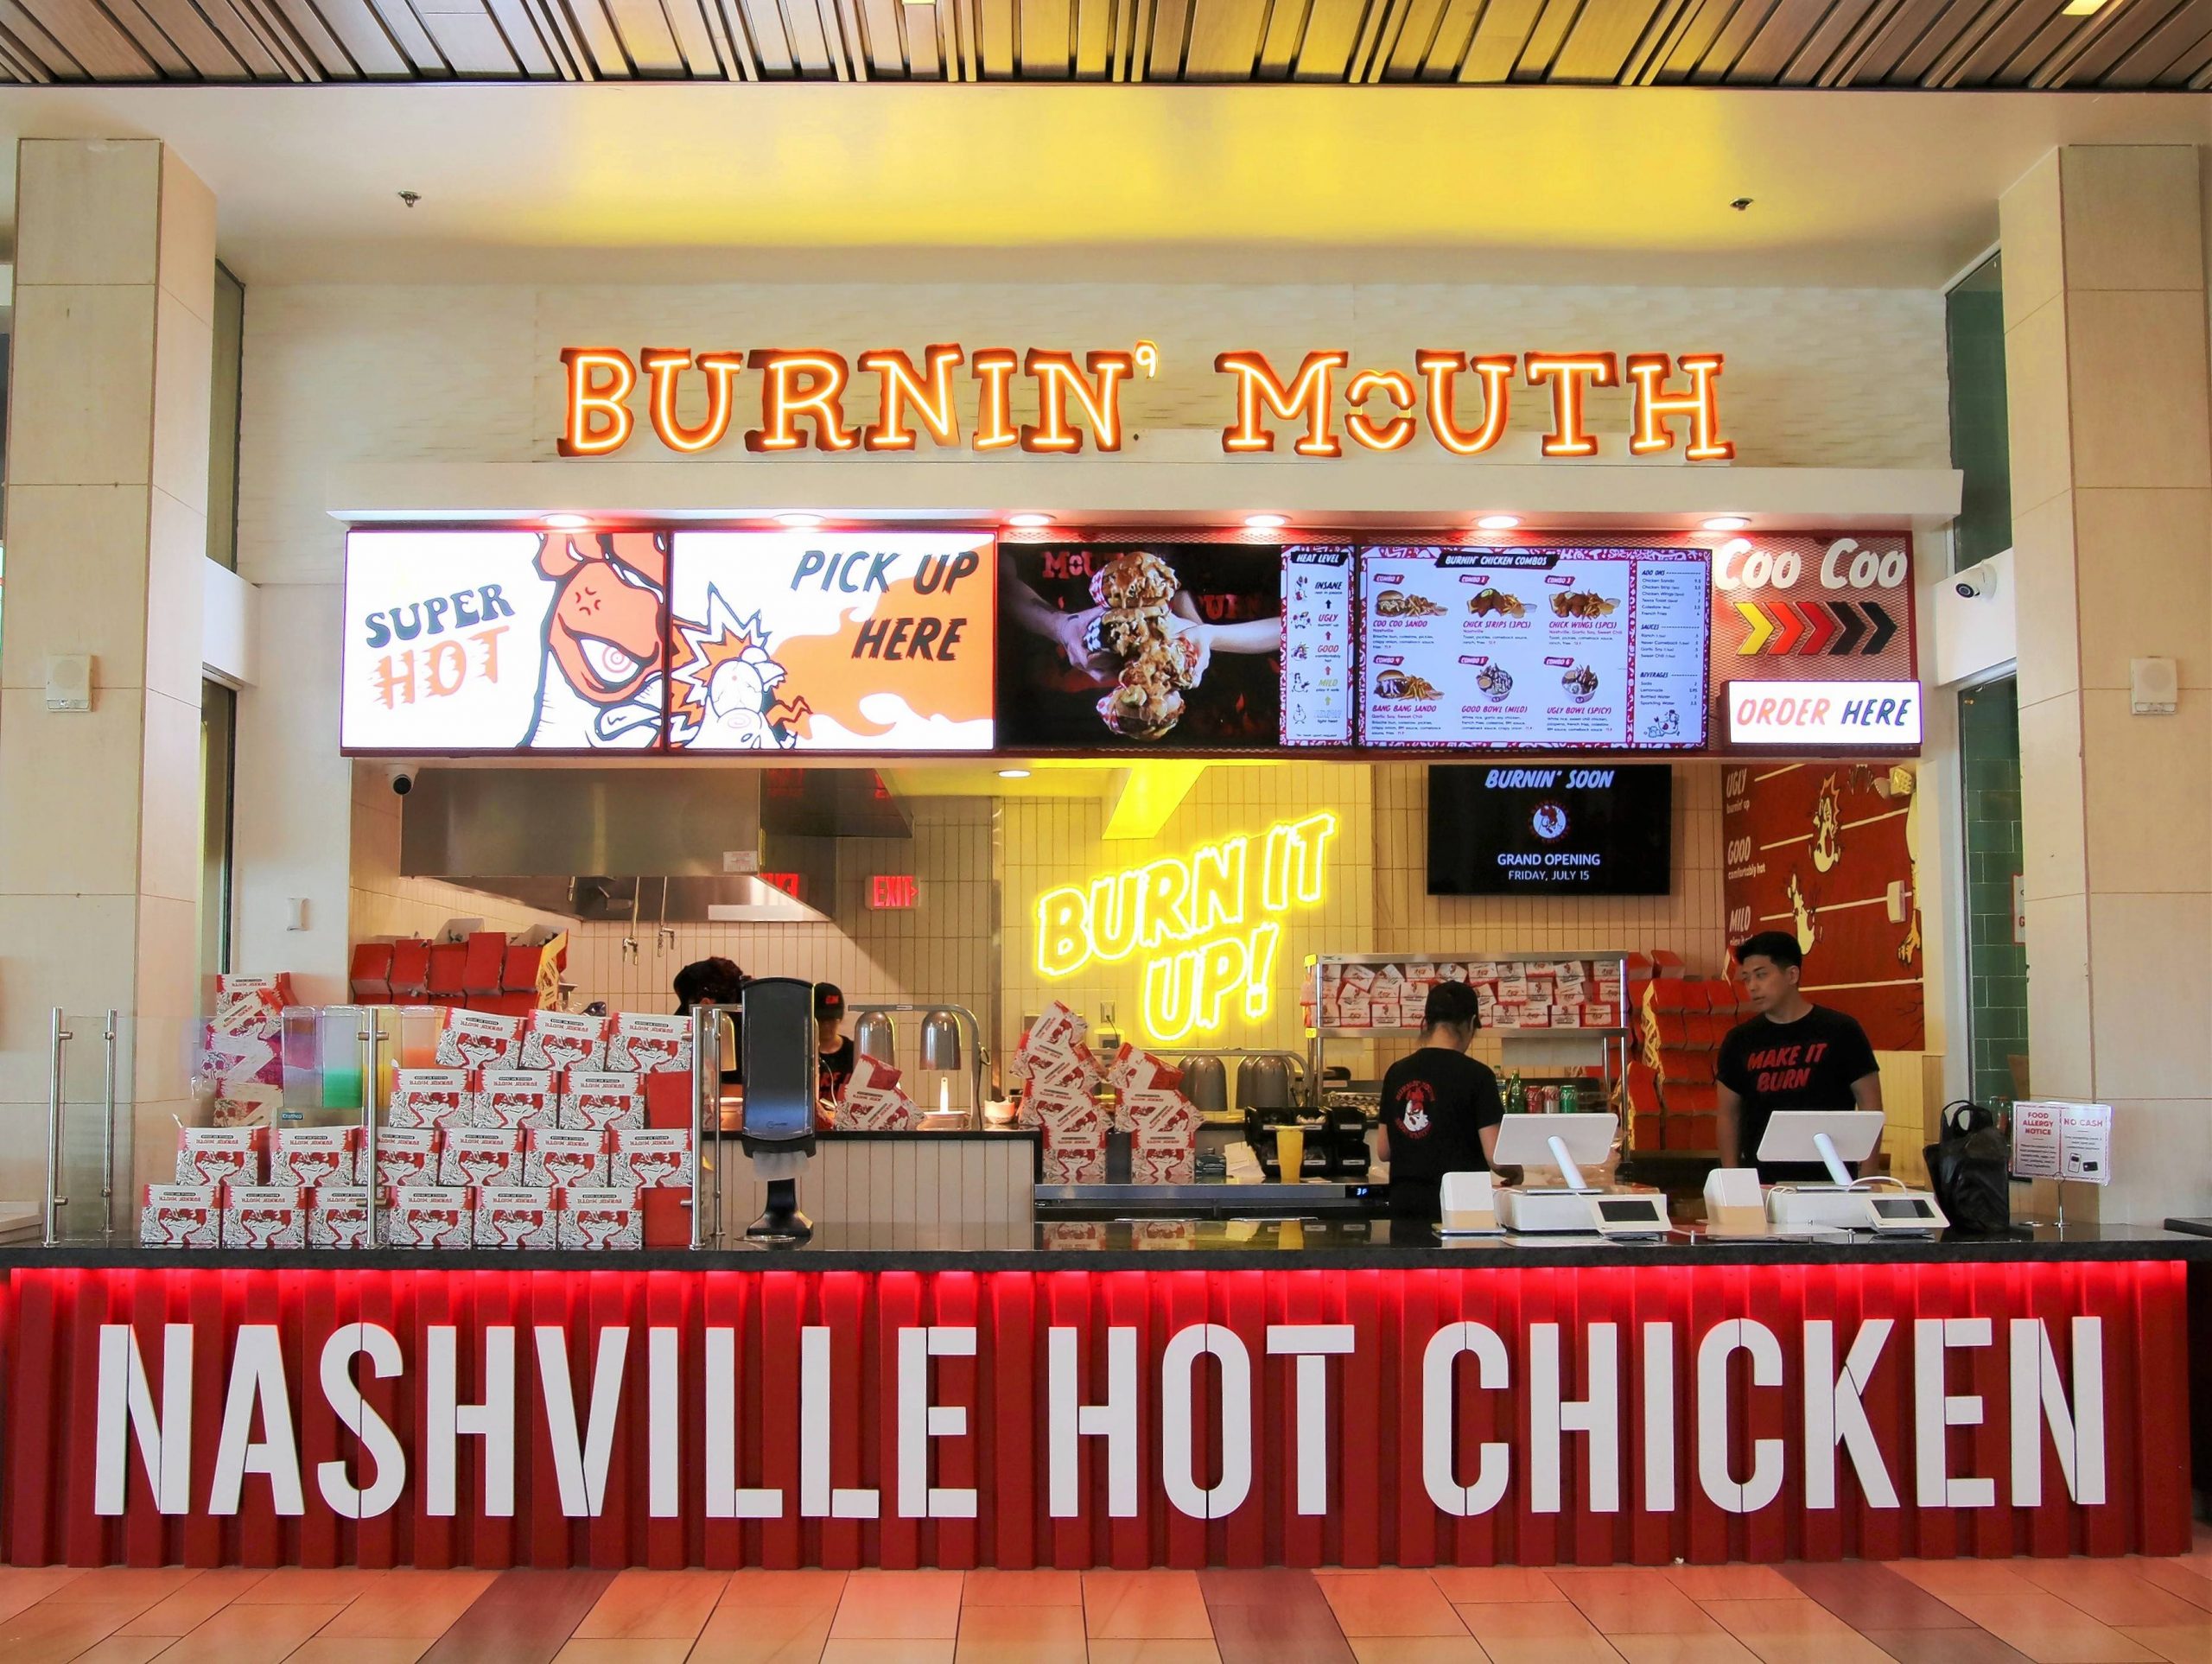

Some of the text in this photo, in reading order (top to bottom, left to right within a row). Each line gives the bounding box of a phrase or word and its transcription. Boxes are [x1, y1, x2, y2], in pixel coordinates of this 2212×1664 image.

[557, 340, 1735, 460] BURNIN' MOUTH
[789, 550, 981, 594] PICK UP
[1296, 553, 1339, 563] HEAT LEVEL
[1445, 556, 1547, 566] BURNIN' CHICKEN COMBOS
[1713, 538, 1908, 591] Coo Coo
[364, 582, 517, 650] SUPER
[850, 616, 969, 661] HERE
[370, 625, 511, 710] HOT
[1737, 698, 1912, 727] ORDER HERE
[1484, 769, 1615, 789] BURNIN' SOON
[1726, 768, 1747, 798] UGLY
[1497, 854, 1600, 865] GRAND OPENING
[1728, 835, 1751, 865] GOOD
[1508, 870, 1589, 881] FRIDAY, JULY 15
[874, 876, 913, 906] EXIT
[1037, 812, 1336, 976] BURN IT
[1729, 905, 1751, 932] MILD
[1144, 923, 1280, 1042] UP!
[1747, 1043, 1828, 1071] MAKE IT
[1756, 1067, 1810, 1093] BURN
[94, 1316, 2106, 1520] NASHVILLE HOT CHICKEN
